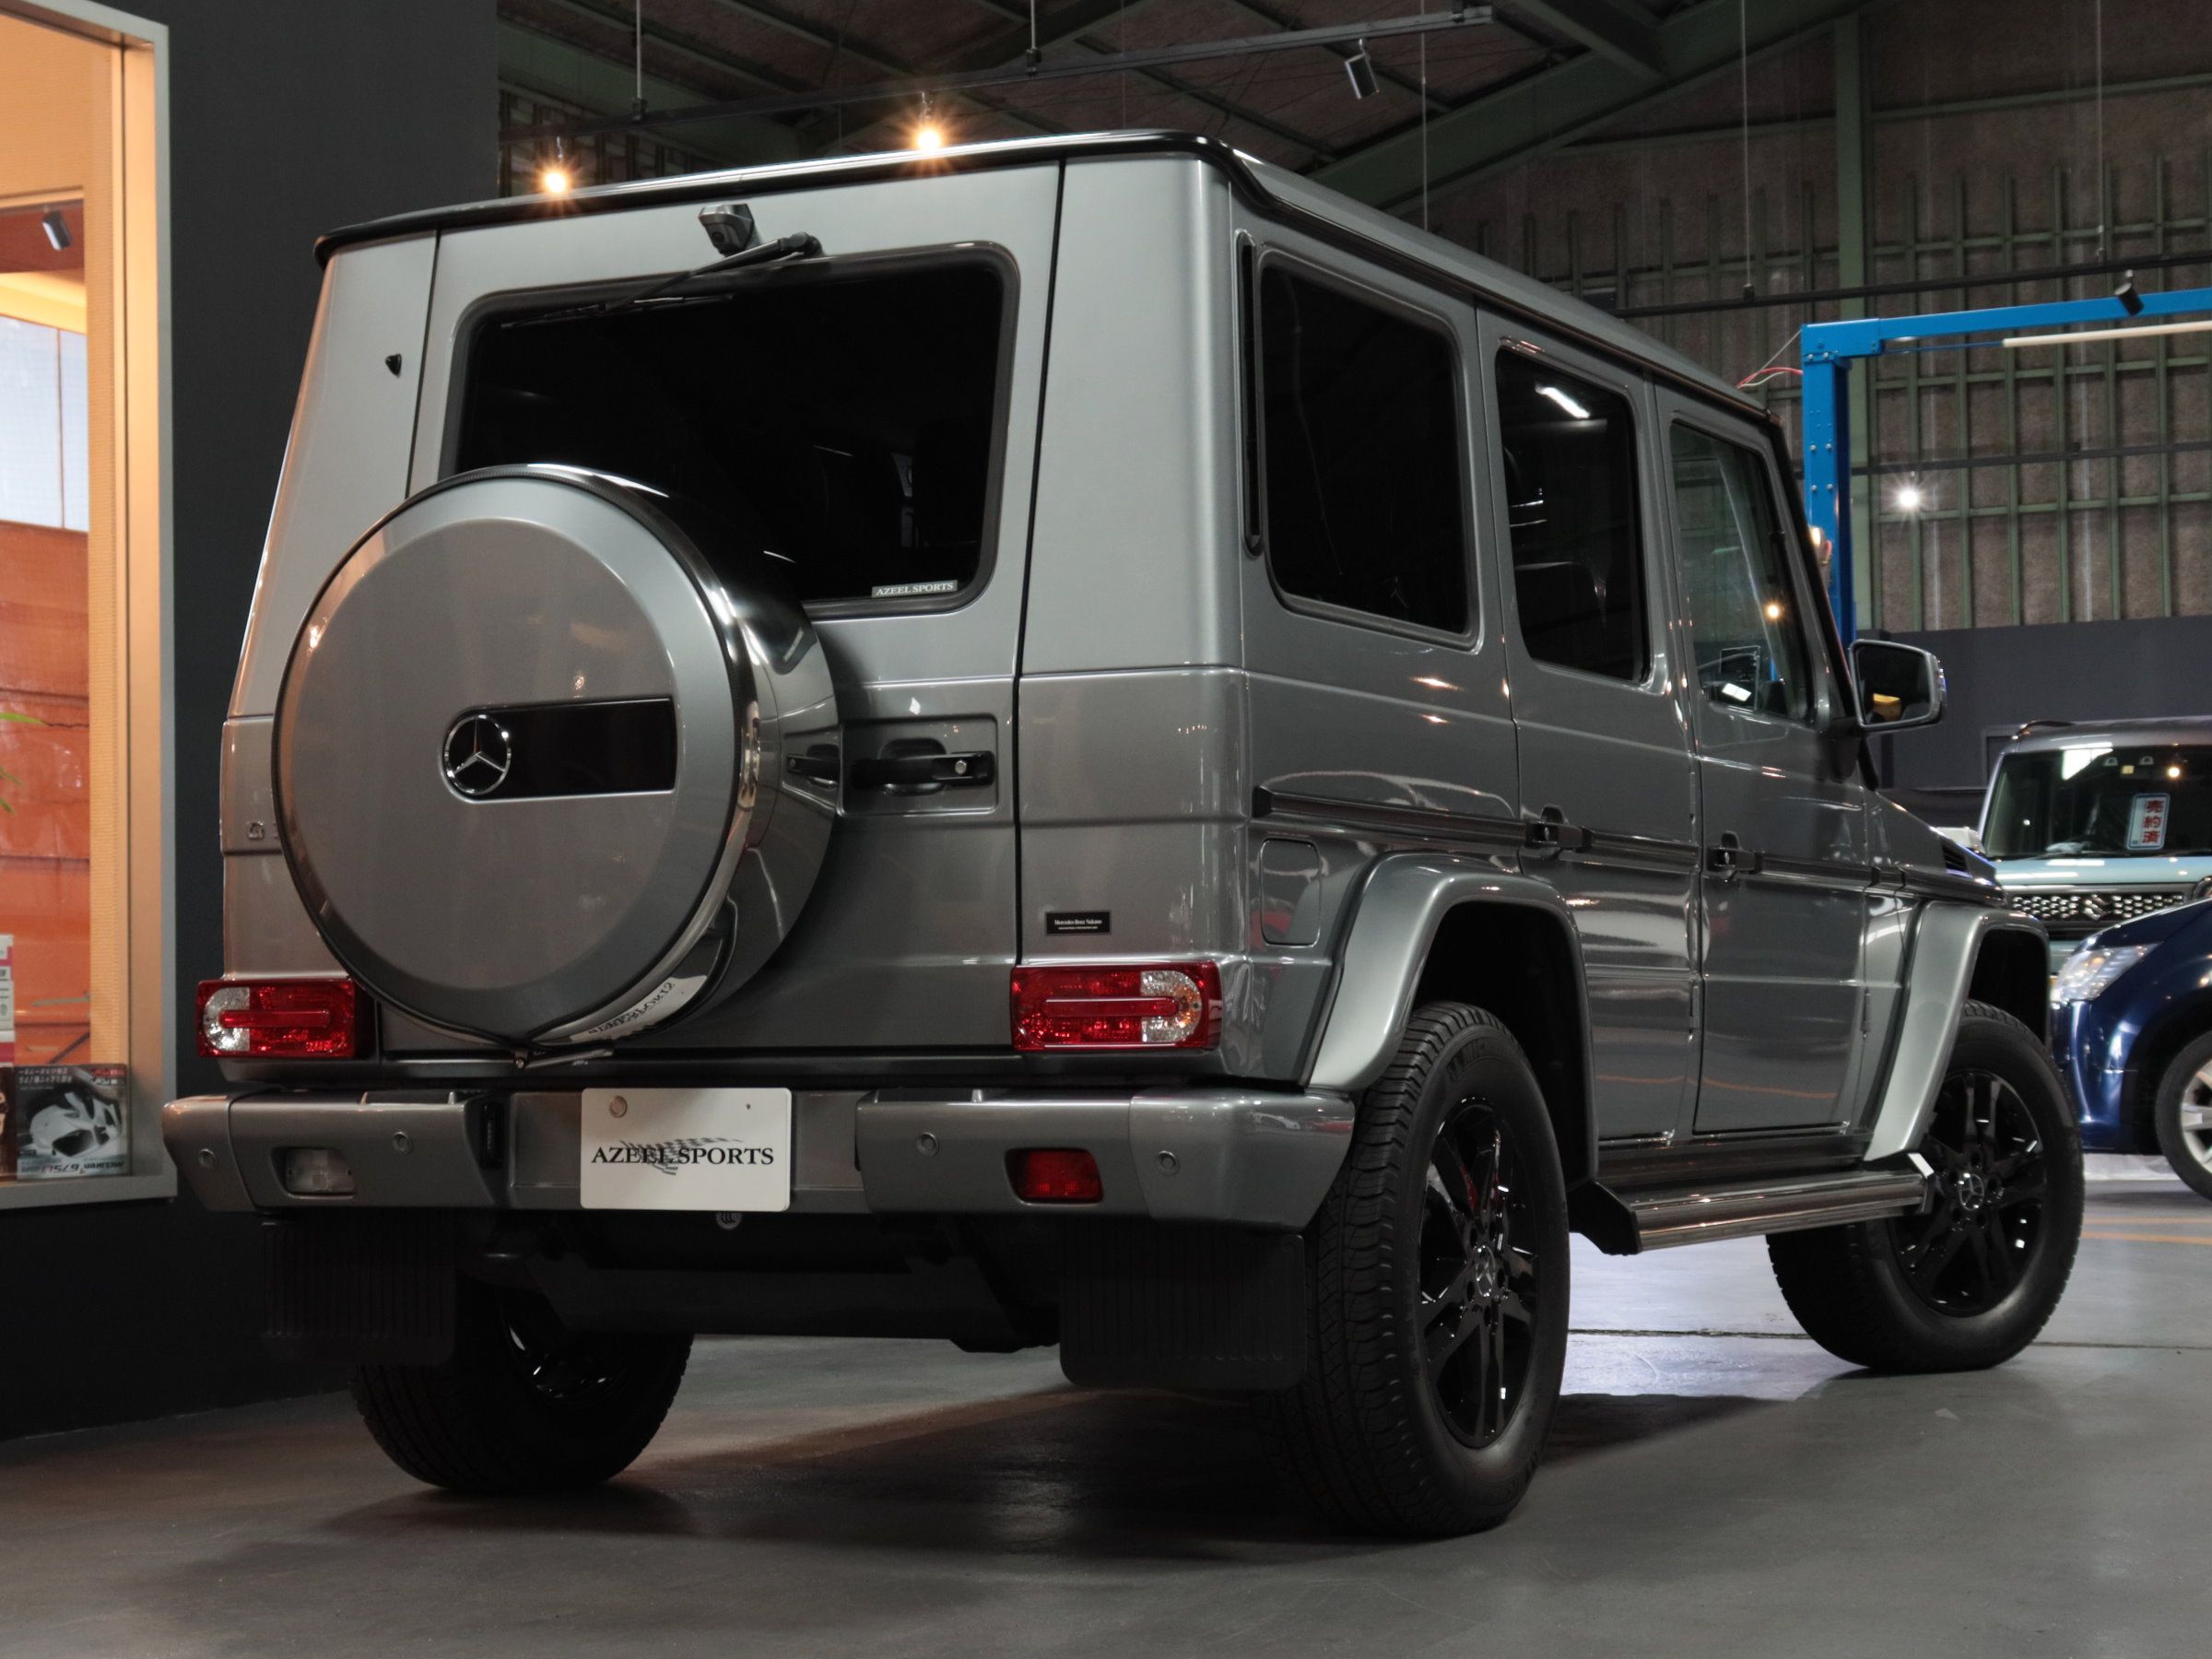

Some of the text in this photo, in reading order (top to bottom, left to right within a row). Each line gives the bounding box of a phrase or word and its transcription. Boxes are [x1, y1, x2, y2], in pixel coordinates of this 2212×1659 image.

[876, 582, 954, 596] AZEEL SPORTS
[2141, 800, 2165, 844] 売約済
[591, 1147, 774, 1165] AZEEL SPORTS
